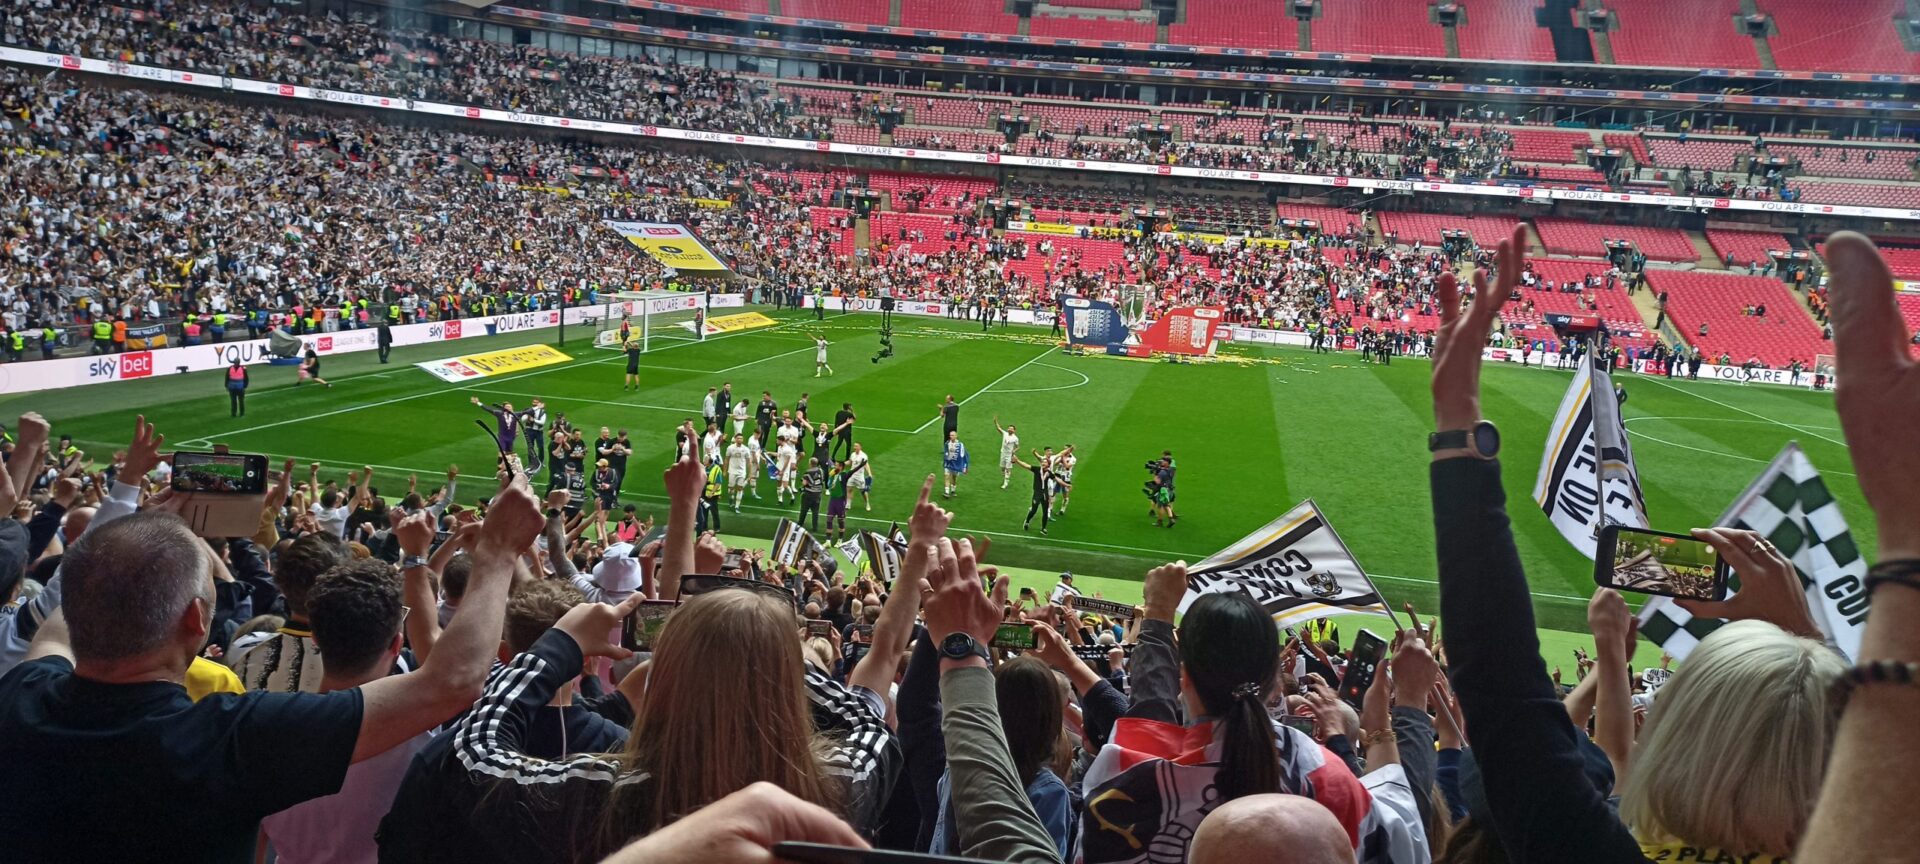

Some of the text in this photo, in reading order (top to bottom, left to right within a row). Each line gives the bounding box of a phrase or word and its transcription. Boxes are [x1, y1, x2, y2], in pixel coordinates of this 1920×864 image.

[349, 95, 364, 104] ARE
[507, 111, 526, 122] YOU
[529, 115, 545, 124] ARE
[683, 131, 702, 139] YOU
[703, 133, 720, 141] ARE
[805, 142, 829, 150] sky bet
[856, 145, 874, 154] YOU
[876, 146, 892, 155] ARE
[976, 154, 986, 162] sky
[1026, 157, 1044, 166] YOU
[1046, 159, 1062, 167] ARE
[1147, 166, 1170, 174] sky bet
[1198, 169, 1216, 177] YOU
[1218, 170, 1234, 178] ARE
[1322, 177, 1333, 185] sky
[1376, 180, 1395, 188] YOU
[1507, 188, 1518, 196] sky
[1562, 191, 1583, 199] YOU
[1586, 192, 1604, 200] ARE
[1760, 202, 1783, 210] YOU
[653, 301, 666, 312] YOU
[667, 298, 678, 309] ARE
[915, 305, 939, 313] sky bet
[492, 316, 513, 332] YOU
[516, 314, 534, 329] ARE
[429, 321, 460, 339] sky bet
[319, 338, 331, 349] bet
[214, 344, 253, 366] YOU
[90, 355, 149, 379] sky bet
[1713, 366, 1781, 382] YOU ARE
